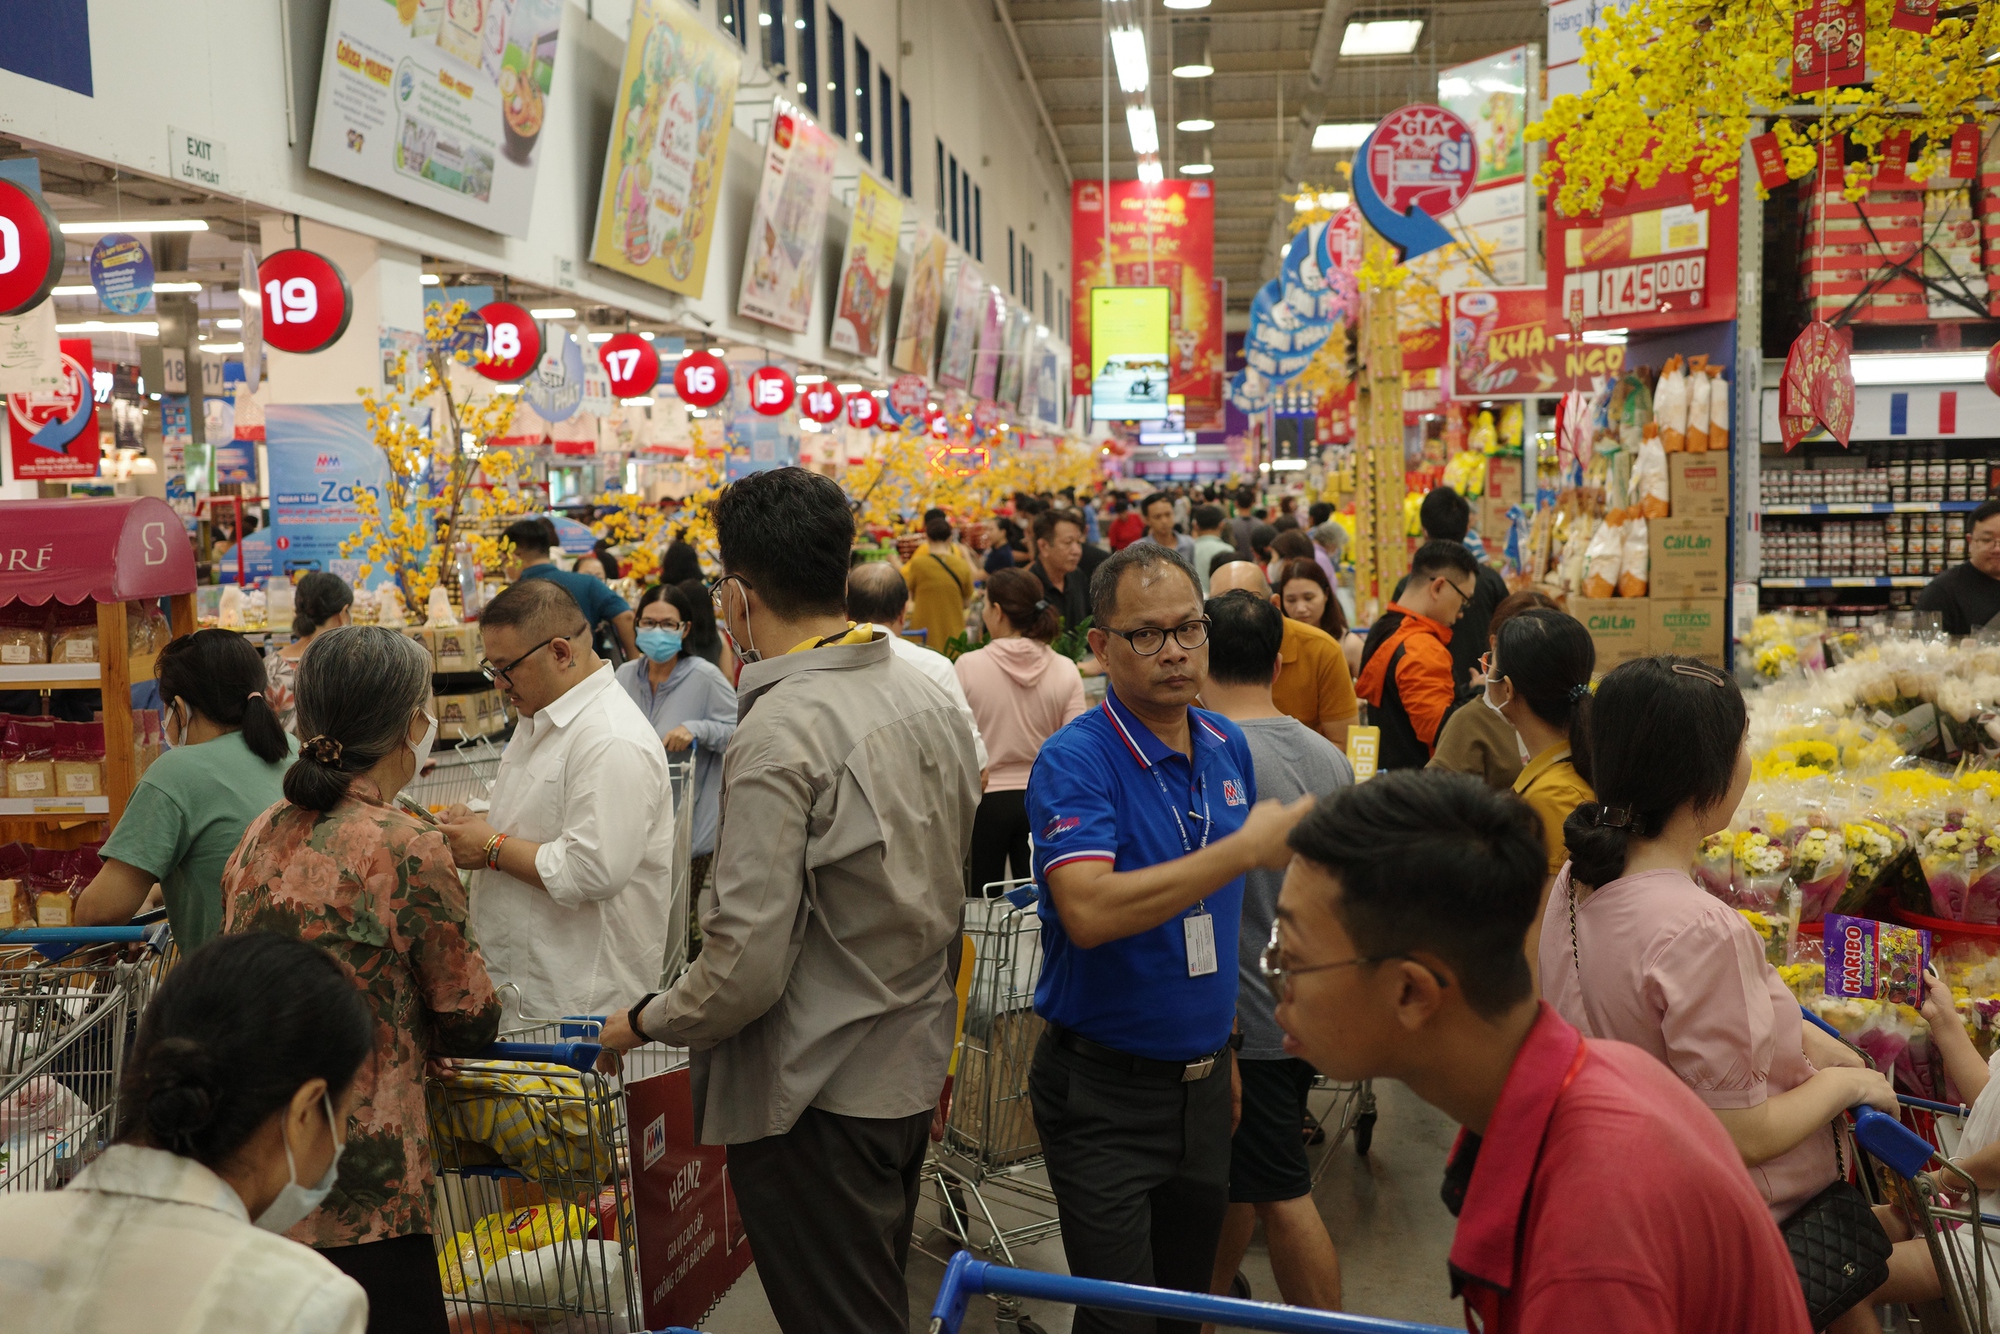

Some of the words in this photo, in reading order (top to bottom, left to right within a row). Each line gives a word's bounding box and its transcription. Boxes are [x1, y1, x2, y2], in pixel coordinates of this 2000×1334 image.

[187, 136, 211, 160] EXIT
[265, 277, 318, 325] 19
[485, 323, 521, 360] 18
[165, 360, 185, 382] 18
[203, 362, 220, 384] 17
[606, 348, 642, 382] 17
[684, 366, 716, 395] 16
[758, 379, 784, 405] 15
[808, 390, 834, 414] 14
[1843, 925, 1863, 994] HARIBO
[668, 1160, 702, 1213] HEINZ
[667, 1240, 677, 1261] GIA
[677, 1233, 683, 1254] VỊ
[682, 1223, 694, 1247] CAO
[693, 1207, 704, 1236] CẤP
[653, 1272, 675, 1307] KHÔNG
[674, 1251, 689, 1284] CHẤT
[689, 1243, 701, 1270] BẢO
[701, 1227, 715, 1257] QUẢN
